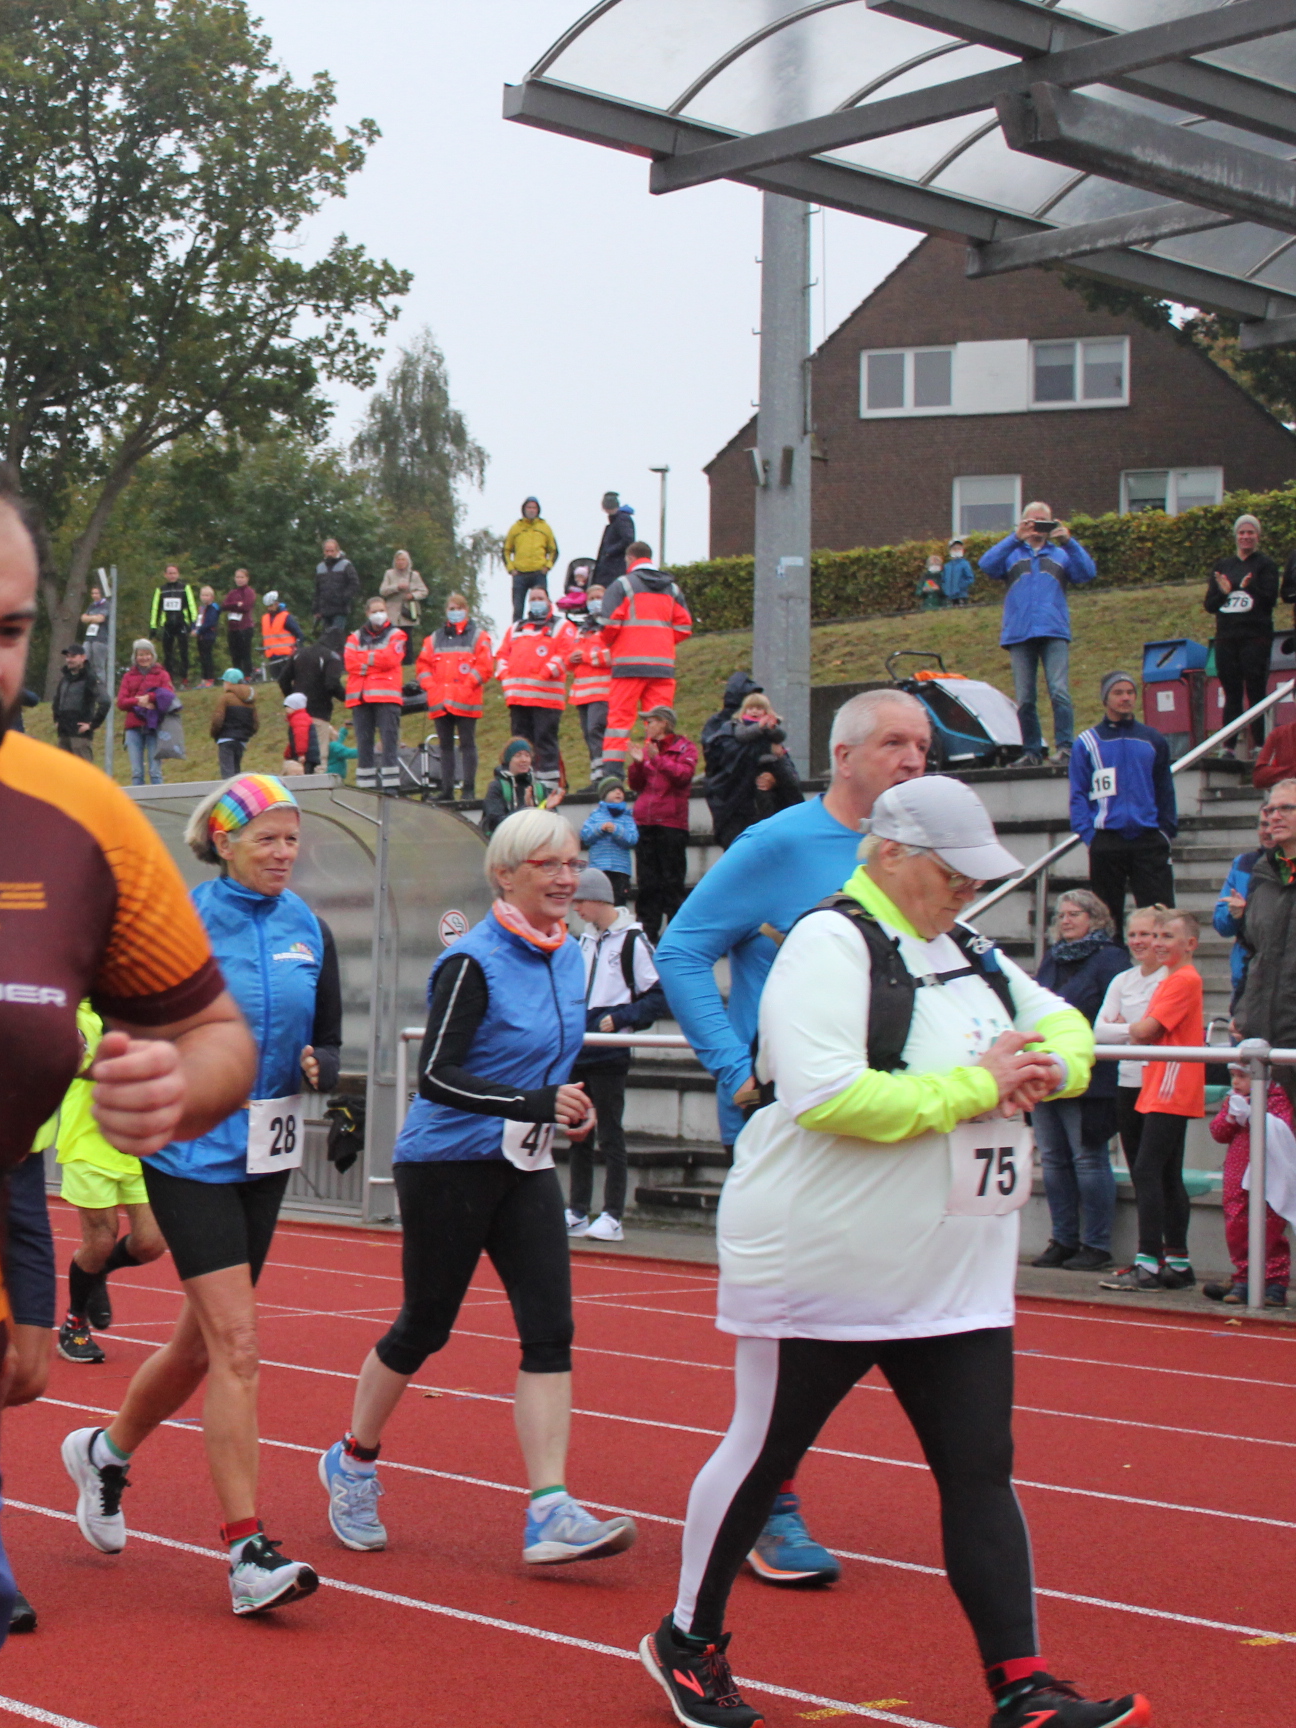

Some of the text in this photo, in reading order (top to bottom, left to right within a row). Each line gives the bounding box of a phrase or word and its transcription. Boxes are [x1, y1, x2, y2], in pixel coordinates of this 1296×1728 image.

[1090, 776, 1111, 792] 16
[269, 1114, 296, 1157] 28
[973, 1147, 1016, 1196] 75
